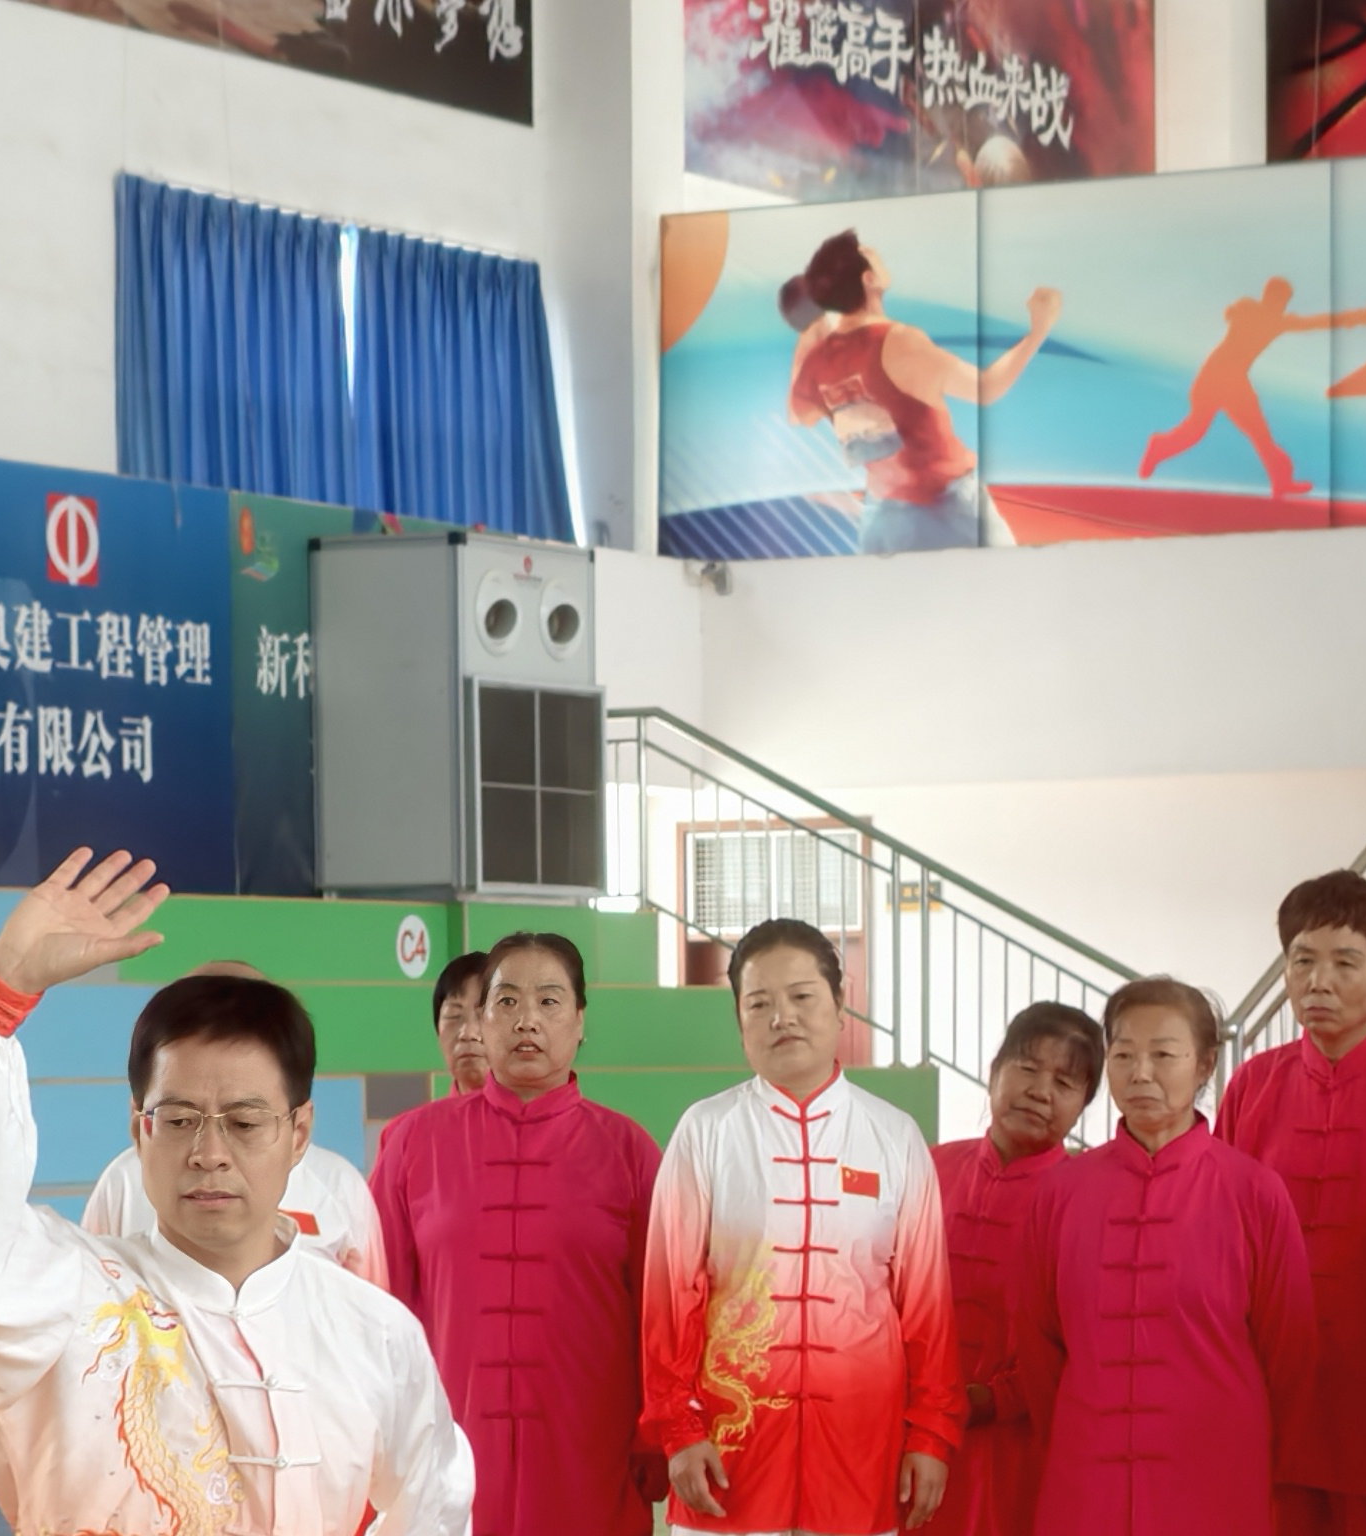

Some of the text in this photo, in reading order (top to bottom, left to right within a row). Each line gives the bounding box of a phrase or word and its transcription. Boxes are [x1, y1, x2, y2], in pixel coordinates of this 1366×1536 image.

[923, 24, 1075, 151] 热血来战
[399, 928, 427, 964] C4
